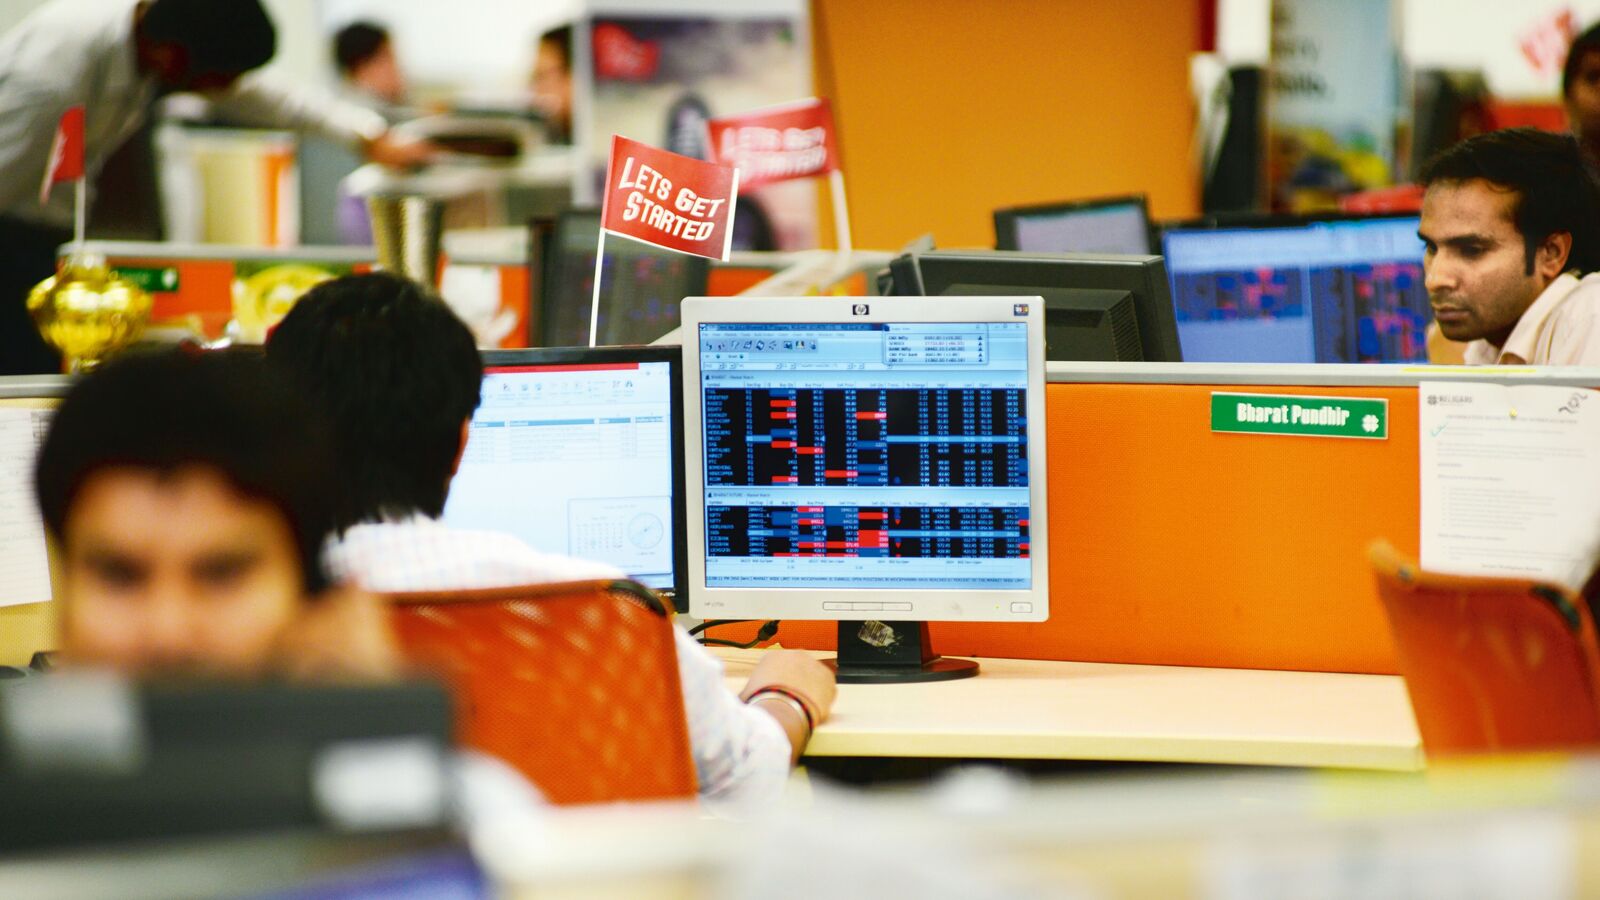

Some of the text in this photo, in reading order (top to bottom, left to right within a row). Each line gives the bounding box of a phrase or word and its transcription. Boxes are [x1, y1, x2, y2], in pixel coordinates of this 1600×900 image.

[618, 156, 726, 219] LETS GET
[622, 191, 715, 242] STARTED
[1236, 402, 1350, 426] Bharat Pundhir
